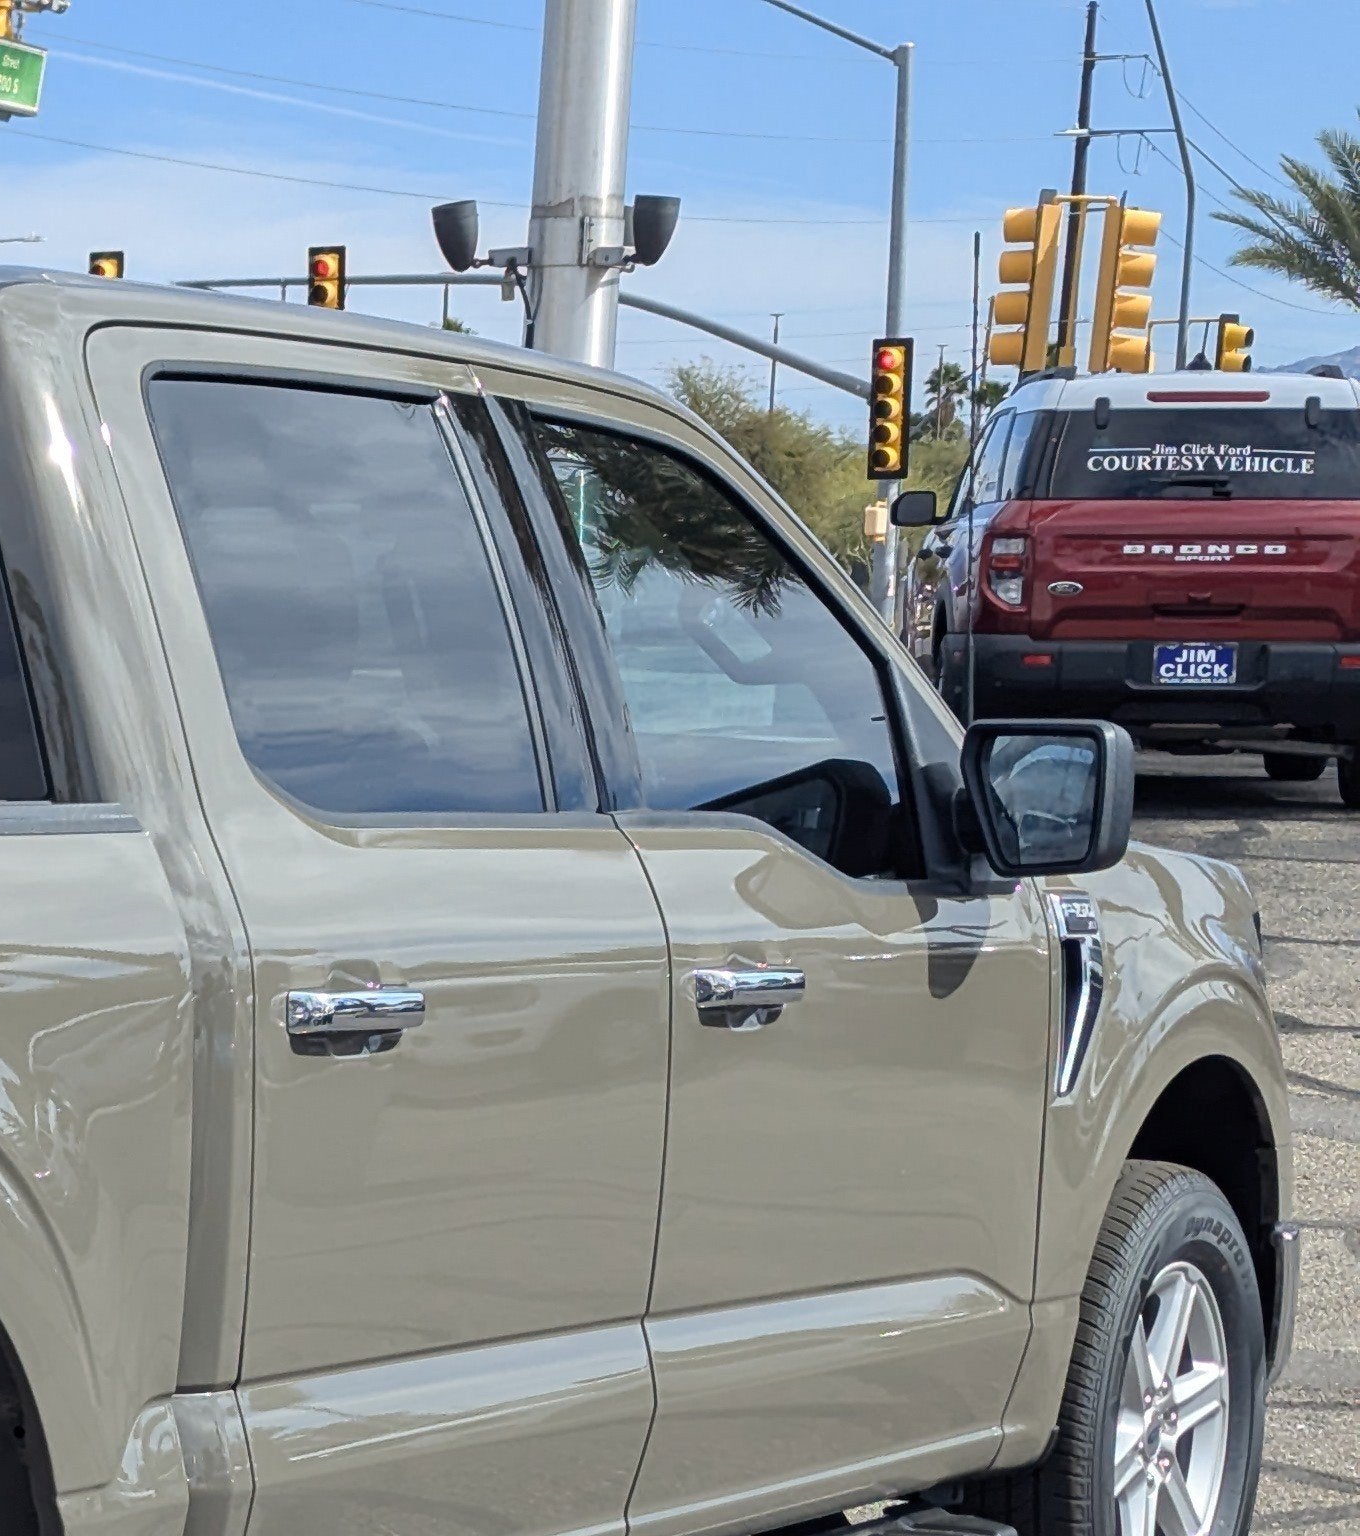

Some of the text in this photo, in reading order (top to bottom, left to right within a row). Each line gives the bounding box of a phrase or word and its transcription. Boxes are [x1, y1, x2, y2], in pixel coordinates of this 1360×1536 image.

[1152, 443, 1252, 457] Jim Click Ford
[1086, 455, 1315, 475] COURTESY VEHICLE
[1122, 544, 1287, 555] BRONCO
[1174, 649, 1217, 663] JIM
[1159, 663, 1229, 678] CLICK
